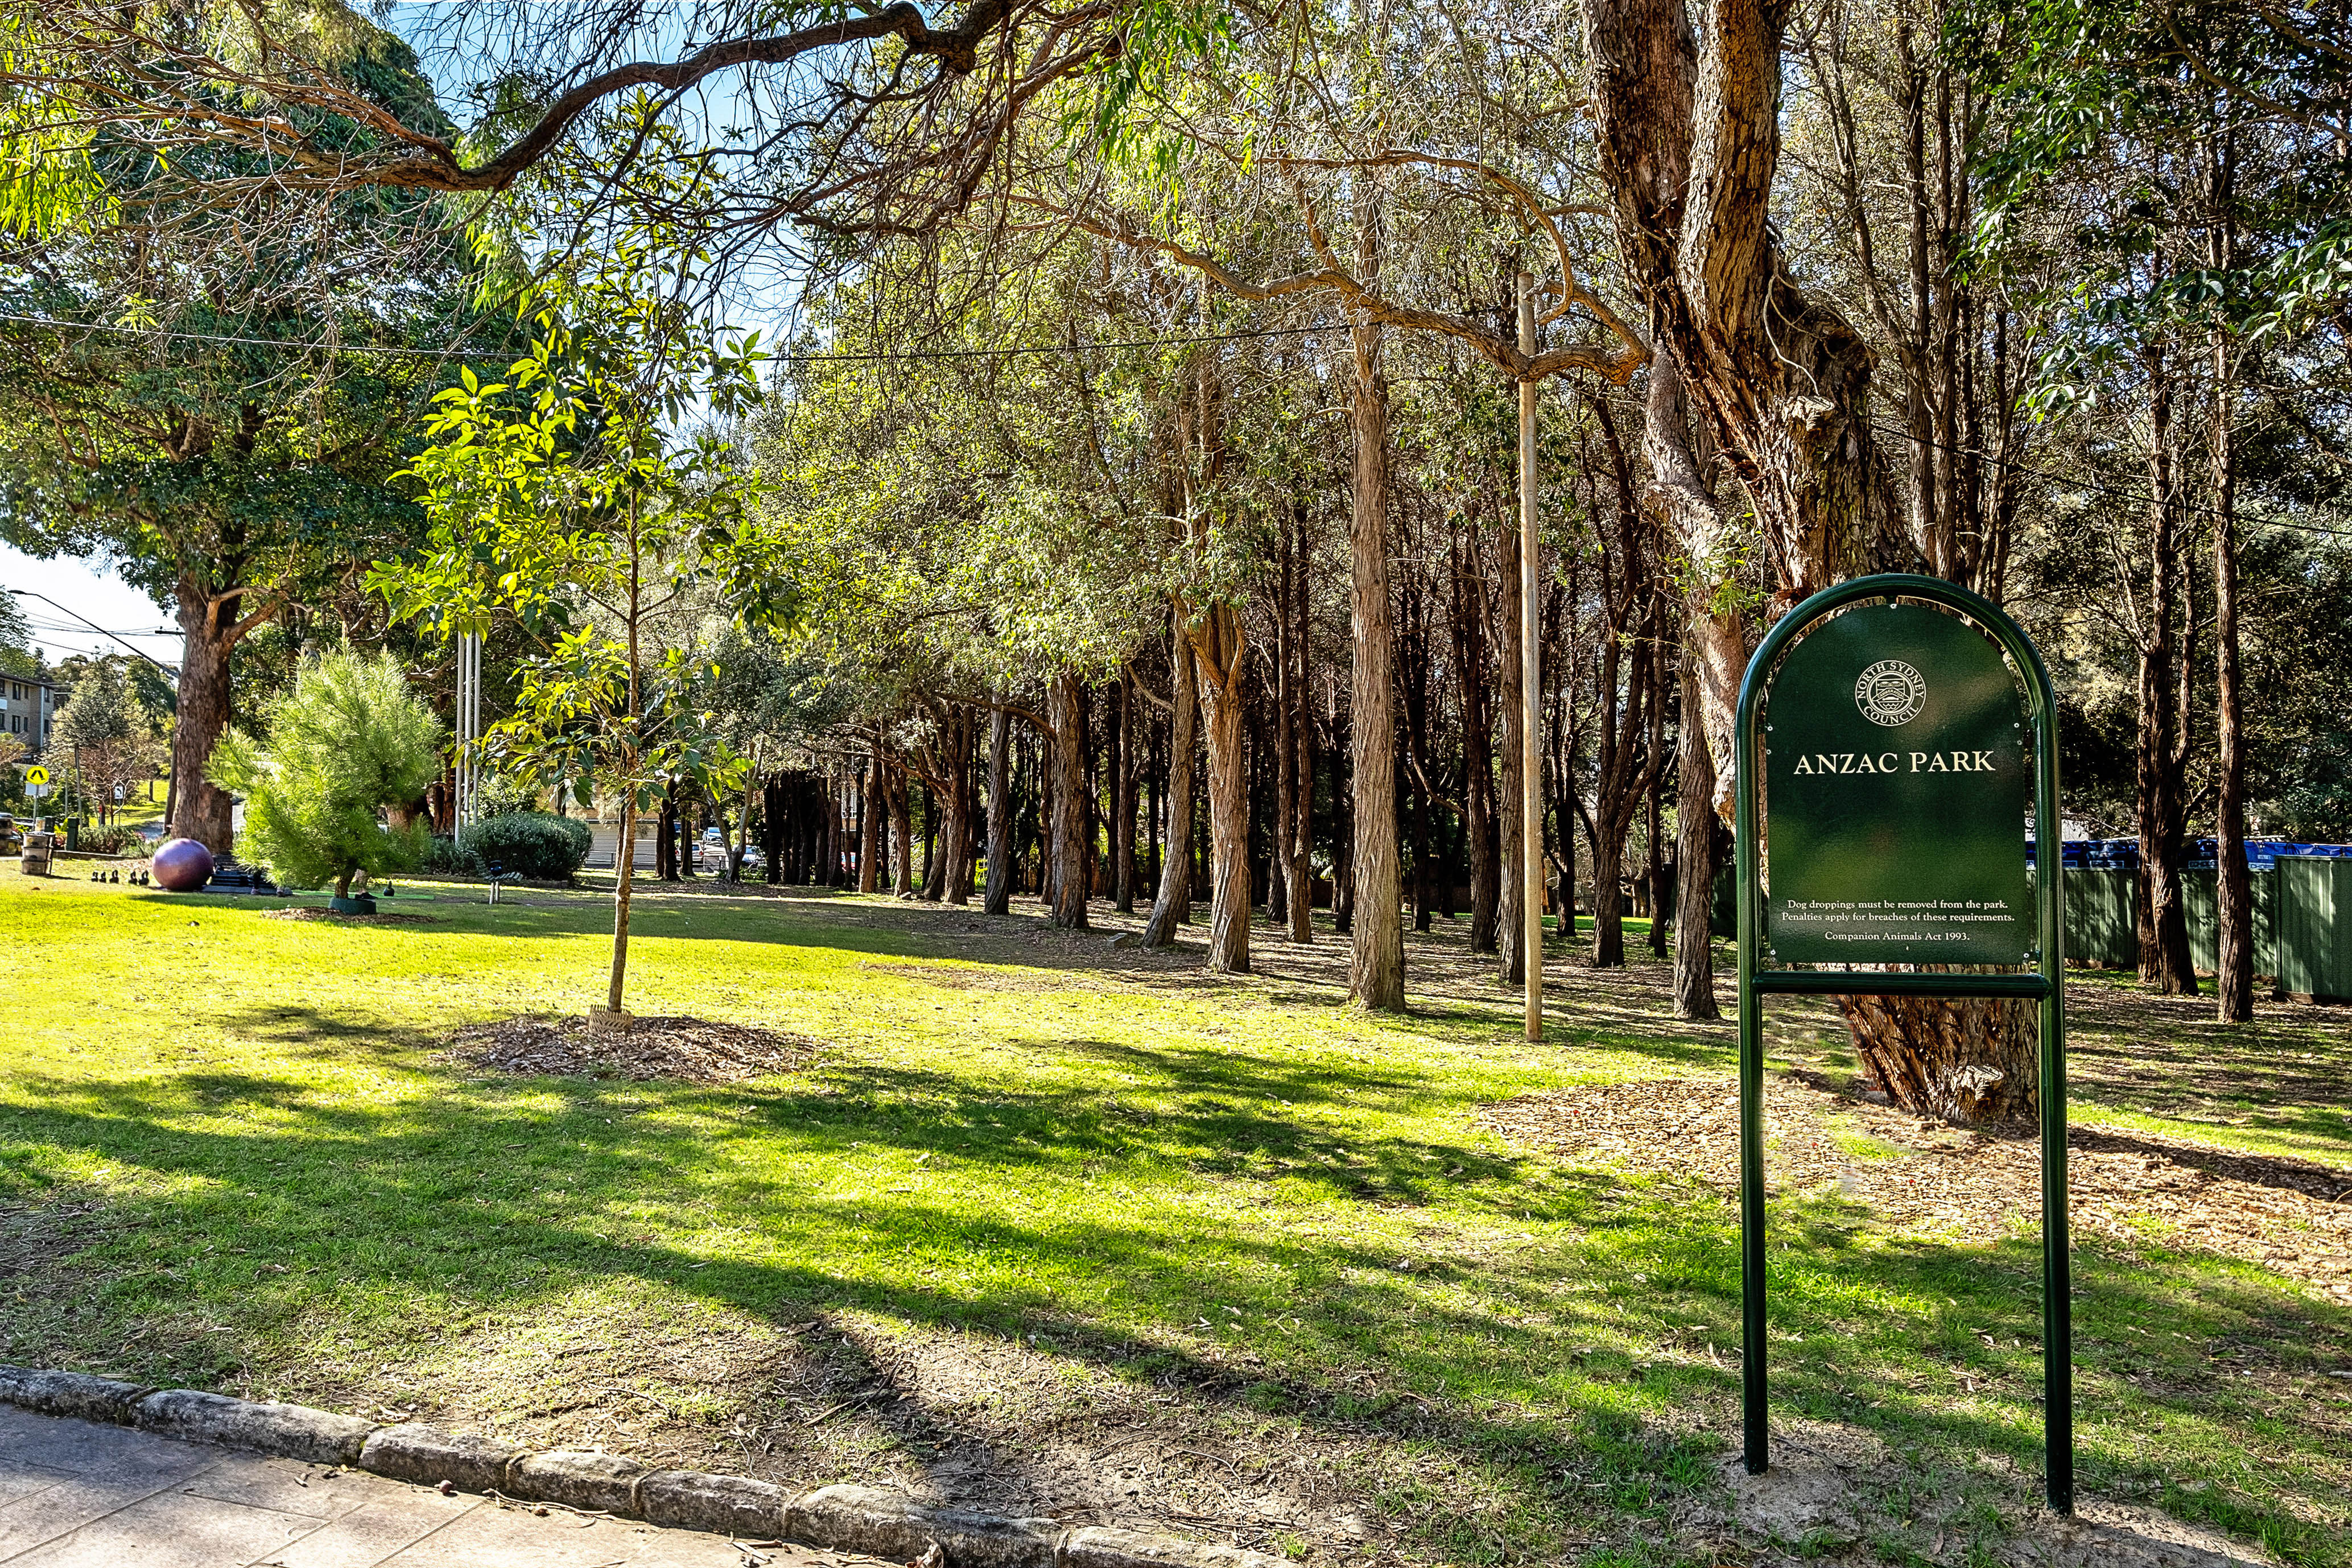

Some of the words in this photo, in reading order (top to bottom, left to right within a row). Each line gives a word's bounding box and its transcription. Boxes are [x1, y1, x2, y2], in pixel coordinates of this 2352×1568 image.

[1857, 662, 1886, 699] NORTH
[1889, 662, 1924, 699] SYDNEY
[1863, 706, 1919, 724] COUNCIL
[1793, 752, 1898, 775] ANZAC
[1909, 750, 1996, 773] PARK
[1787, 899, 1807, 910] Dog
[1809, 899, 1855, 910] droppings
[1884, 899, 1895, 909] be
[1897, 899, 1937, 909] removed
[1940, 899, 1963, 909] from
[1966, 899, 1981, 909] the
[1984, 899, 2008, 910] park.
[1781, 912, 1822, 921] Penalties
[1825, 912, 1850, 922] apply
[1852, 912, 1867, 921] for
[1868, 912, 1908, 921] breaches
[1911, 912, 1921, 921] of
[1923, 912, 1947, 921] these
[1950, 913, 2015, 923] requirements.
[1825, 931, 1880, 942] Companion
[1882, 931, 1922, 940] Animals
[1925, 931, 1942, 940] Act
[1945, 932, 1970, 940] 1993.
